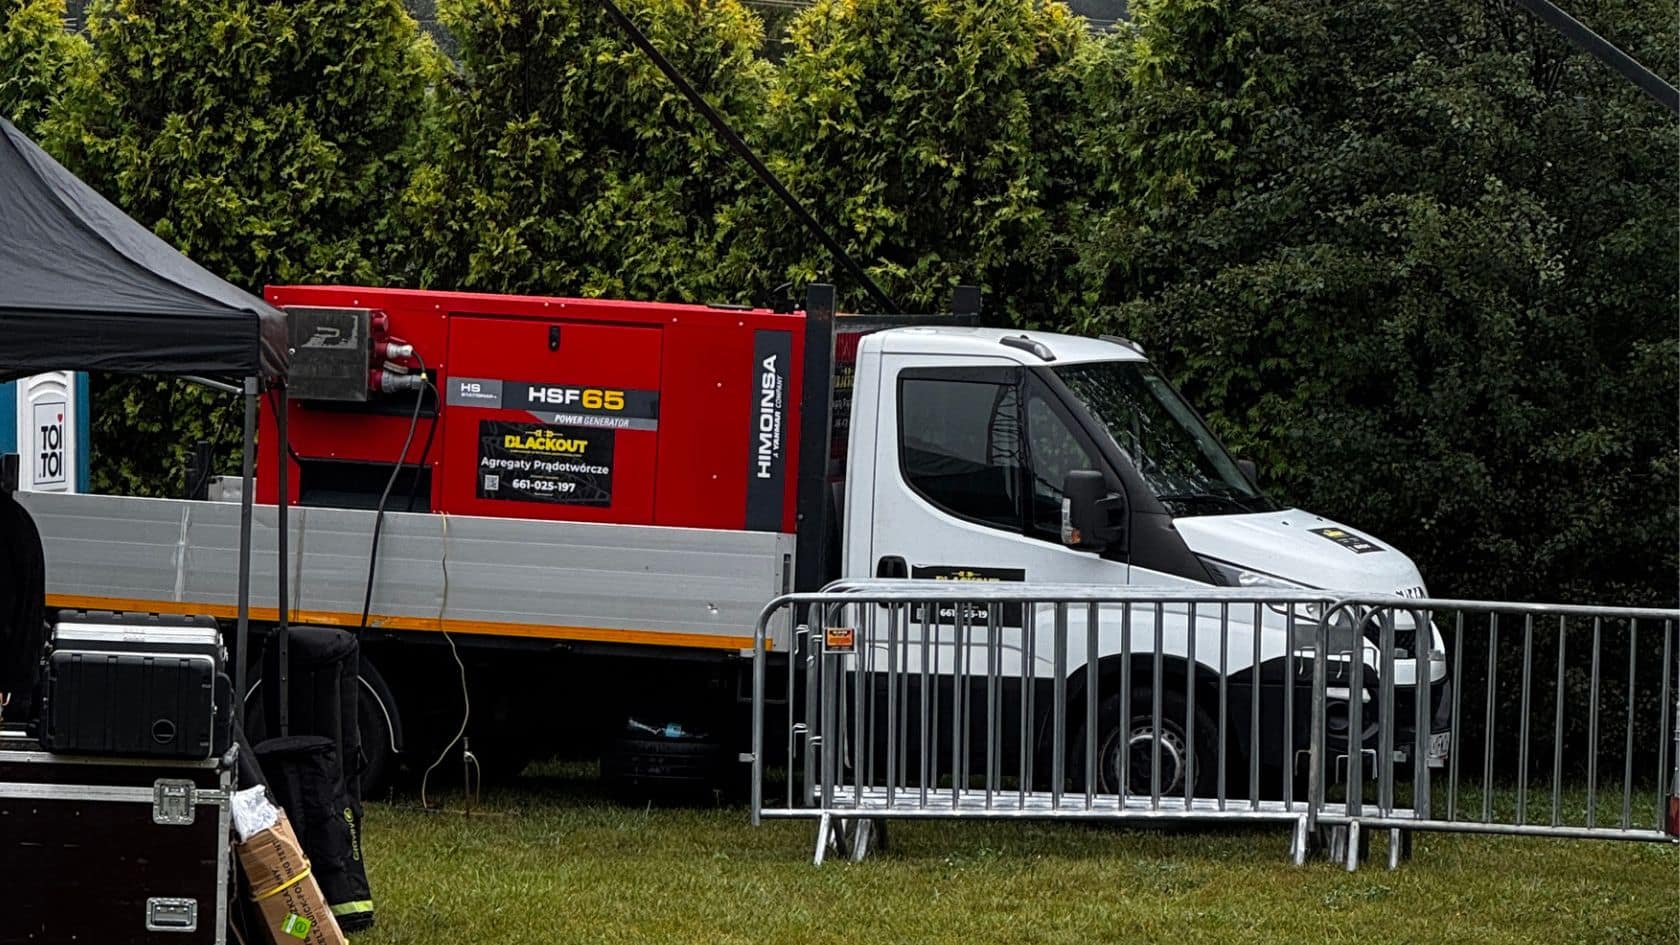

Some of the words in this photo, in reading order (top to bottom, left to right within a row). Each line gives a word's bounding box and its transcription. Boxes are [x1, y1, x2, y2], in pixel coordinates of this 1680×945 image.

[461, 383, 481, 393] HS
[775, 375, 784, 409] COMPANY
[554, 414, 582, 424] POWER
[583, 416, 629, 428] GENERATOR
[757, 355, 777, 478] HIMOINSA
[41, 424, 63, 451] TOI
[772, 411, 782, 451] YANMAR
[504, 434, 588, 453] BLACKOUT
[481, 457, 531, 471] Agregaty
[533, 460, 609, 475] Prądotwórcze
[512, 478, 576, 493] 661-025-197
